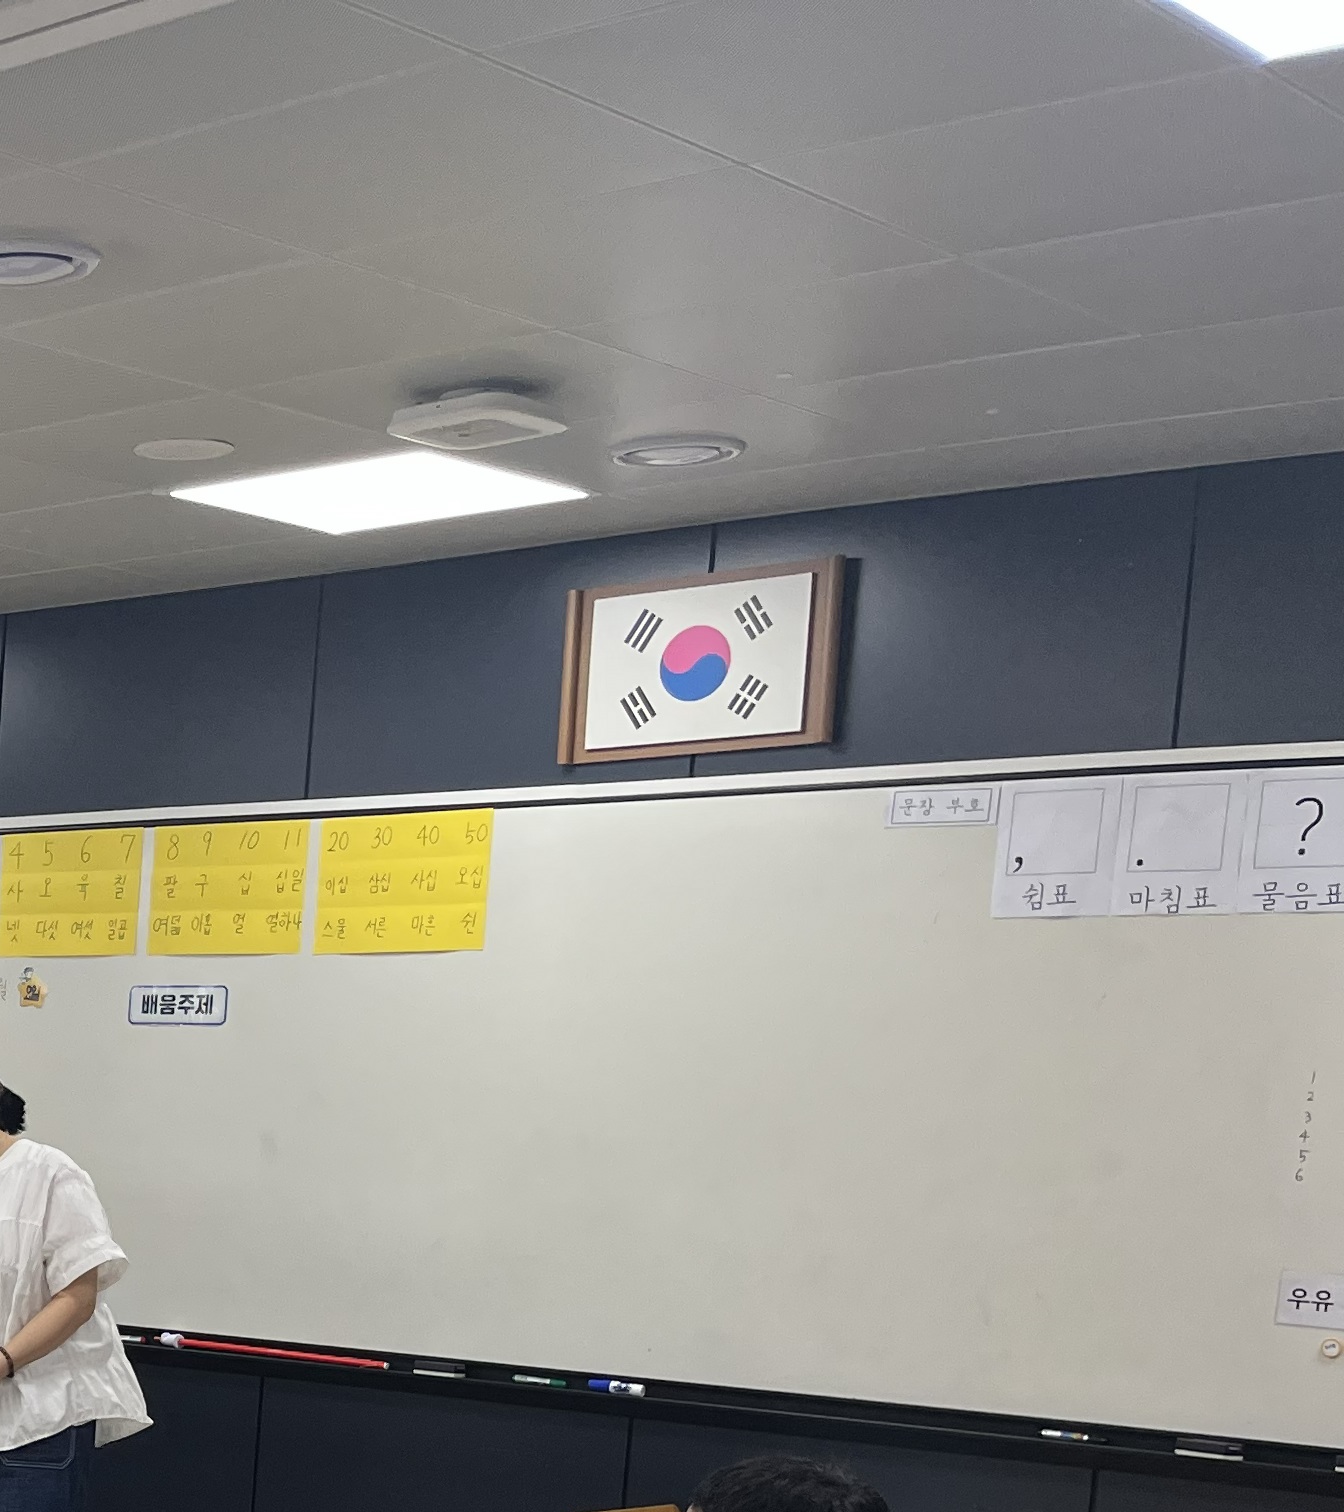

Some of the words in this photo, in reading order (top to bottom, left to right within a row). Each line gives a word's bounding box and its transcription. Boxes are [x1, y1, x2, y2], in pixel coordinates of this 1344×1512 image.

[898, 798, 935, 817] 문장
[327, 831, 350, 852] 20
[371, 826, 393, 849] 30
[416, 825, 440, 847] 40
[465, 823, 488, 844] 50
[1295, 797, 1324, 856] ?
[9, 841, 24, 869] 4
[42, 839, 53, 866] 5
[80, 835, 93, 863] 6
[120, 834, 136, 864] 7
[166, 834, 179, 861] 8
[202, 831, 212, 856] 9
[239, 830, 260, 850] 10
[284, 828, 302, 850] 11
[7, 880, 23, 903] 사
[39, 878, 52, 898] 오
[77, 874, 90, 901] 육
[114, 874, 127, 899] 칠
[163, 876, 179, 898] 팔
[194, 874, 209, 897] 구
[238, 872, 253, 895] 십
[276, 868, 304, 894] 십일
[325, 875, 348, 895] 이십
[368, 871, 391, 893] 삼십
[411, 869, 437, 892] 사십
[455, 865, 484, 889] 오십
[1021, 882, 1077, 911] 쉼표
[1129, 885, 1217, 914] 마침표
[1252, 881, 1344, 912] 물음표
[7, 920, 20, 942] 넷
[36, 919, 58, 941] 다섯
[70, 919, 94, 941] 여섯
[108, 919, 128, 941] 일곱
[153, 915, 181, 937] 여덟
[190, 914, 212, 936] 아홉
[232, 912, 246, 935] 열
[265, 911, 302, 934] 열하나
[322, 918, 346, 940] 스물
[365, 917, 387, 938] 서른
[411, 915, 436, 937] 마흔
[460, 912, 477, 935] 쉰
[141, 994, 214, 1016] 배움주제
[1311, 1070, 1316, 1084] 1
[1306, 1091, 1314, 1101] 2
[1305, 1111, 1312, 1124] 3
[1298, 1129, 1310, 1143] 4
[1299, 1149, 1311, 1163] 5
[1295, 1168, 1304, 1182] 6
[1287, 1288, 1334, 1312] 우유
